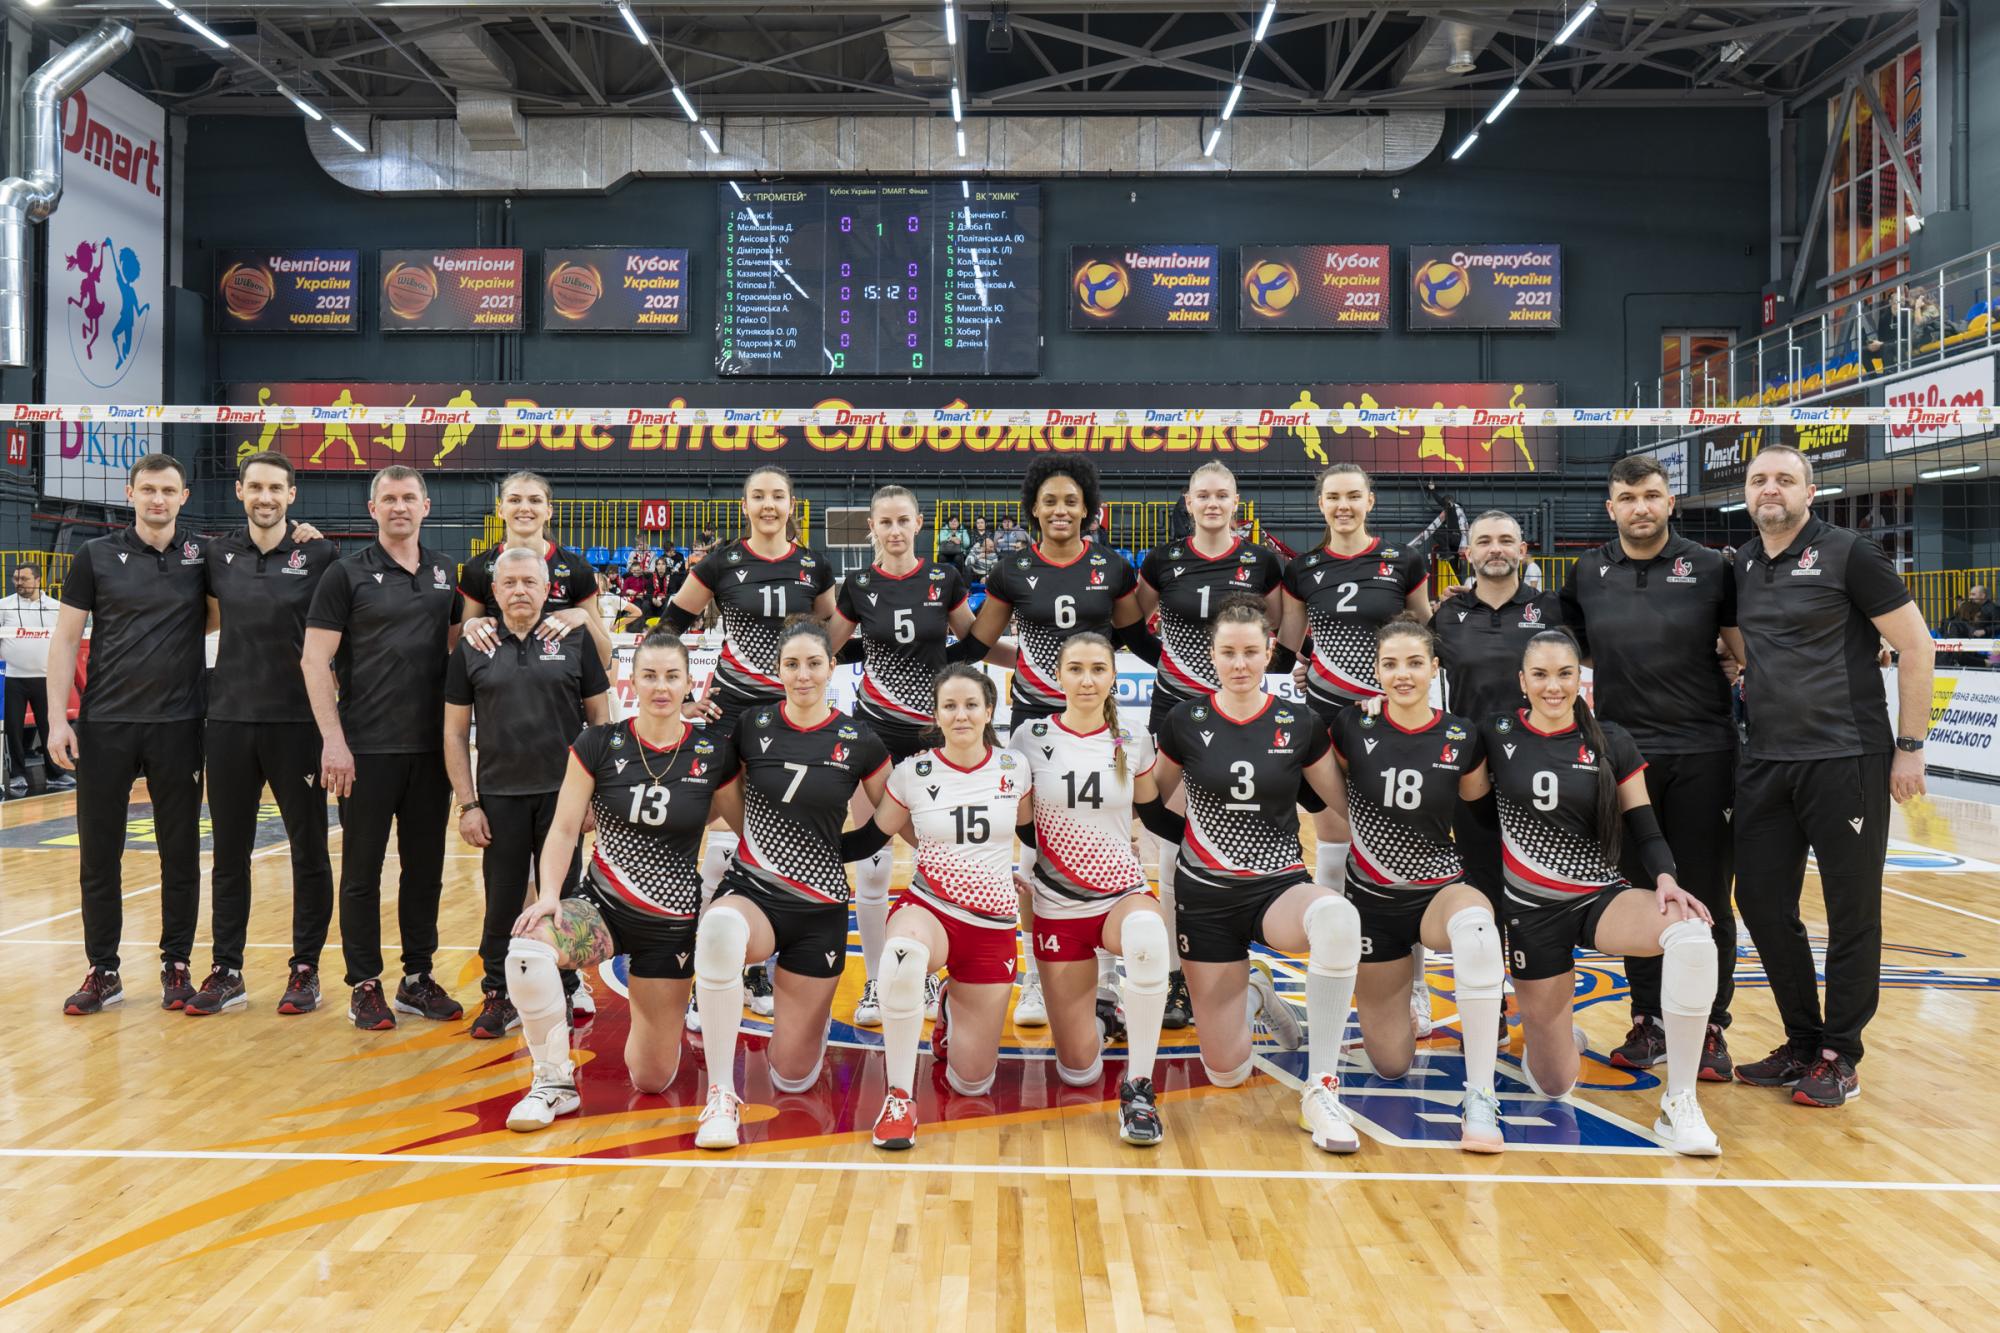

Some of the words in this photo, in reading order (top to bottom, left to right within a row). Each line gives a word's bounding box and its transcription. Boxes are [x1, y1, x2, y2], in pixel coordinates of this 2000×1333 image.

[830, 188, 849, 196] Кубок
[851, 188, 876, 196] України
[976, 193, 987, 201] ВК
[727, 223, 733, 231] 2
[841, 216, 851, 232] 0
[876, 223, 882, 236] 1
[908, 216, 918, 232] 0
[728, 235, 733, 243] 3
[739, 235, 769, 243] Анісова
[957, 234, 1003, 243] Політанська
[1004, 234, 1012, 242] А.
[1014, 234, 1025, 243] (К)
[737, 247, 773, 256] Дімітрова
[269, 256, 351, 272] Чемпіони
[433, 256, 515, 271] Чемпіони
[626, 256, 680, 274] Кубок
[1125, 252, 1210, 268] Чемпіони
[1325, 253, 1380, 271] Кубок
[1451, 252, 1551, 269] Суперкубок
[727, 269, 733, 278] 6
[737, 270, 771, 278] Казанова
[841, 263, 850, 277] 0
[908, 263, 917, 277] 0
[295, 277, 351, 292] України
[459, 276, 514, 291] України
[623, 275, 679, 291] України
[1152, 273, 1210, 288] України
[1323, 273, 1380, 288] України
[1493, 272, 1552, 288] України
[727, 292, 733, 301] 9
[737, 293, 781, 302] Герасимова
[841, 286, 850, 300] 0
[908, 286, 917, 300] 0
[1173, 292, 1210, 306] 2021
[1344, 292, 1380, 306] 2021
[1515, 291, 1552, 305] 2021
[315, 295, 351, 309] 2021
[480, 295, 514, 308] 2021
[643, 295, 679, 309] 2021
[736, 304, 781, 313] Харчинська
[782, 304, 790, 312] А.
[290, 311, 351, 324] чоловіки
[473, 311, 514, 323] жінки
[637, 311, 679, 323] жінки
[841, 310, 850, 324] 0
[908, 310, 917, 324] 0
[1167, 309, 1210, 321] жінки
[1337, 309, 1380, 321] жінки
[1509, 308, 1552, 320] жінки
[1764, 298, 1774, 325] B1
[737, 316, 759, 324] Гейко
[957, 316, 993, 324] Маєвська
[736, 328, 775, 337] Кутнякова
[786, 327, 798, 336] (Л)
[956, 328, 981, 337] Хобер
[736, 339, 773, 349] Тодорова
[785, 339, 797, 348] (Л)
[841, 333, 850, 347] 0
[908, 333, 917, 347] 0
[956, 339, 983, 349] Деніна
[834, 352, 845, 368] 0
[912, 352, 923, 368] 0
[10, 435, 25, 461] A7
[644, 505, 668, 527] A8
[759, 586, 786, 617] 11
[1197, 585, 1211, 618] 1
[1336, 582, 1359, 612] 2
[1054, 595, 1076, 629] 6
[894, 608, 915, 644] 5
[782, 762, 808, 803] 7
[1229, 760, 1256, 801] 3
[1061, 771, 1103, 809] 14
[1380, 767, 1423, 810] 18
[1532, 770, 1558, 811] 9
[629, 783, 671, 826] 13
[950, 805, 991, 845] 15
[1036, 932, 1061, 953] 14
[1178, 934, 1190, 953] 3
[1514, 950, 1526, 969] 9
